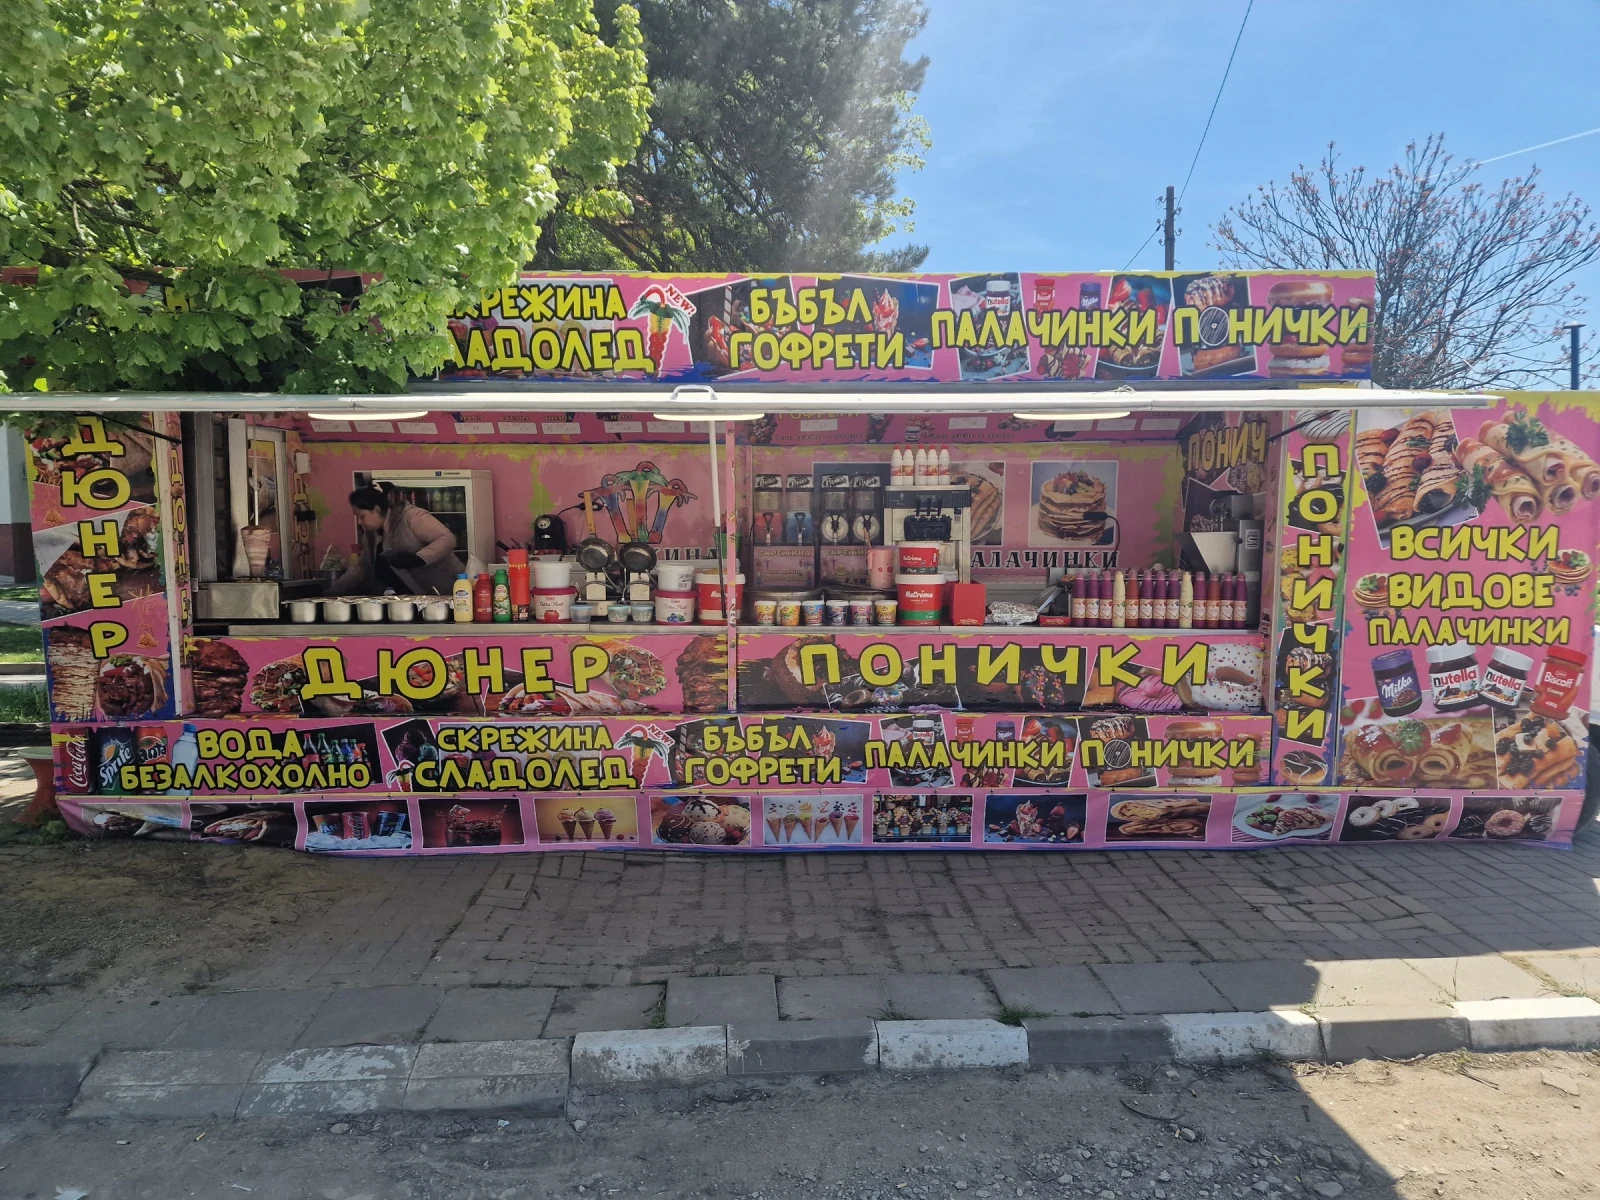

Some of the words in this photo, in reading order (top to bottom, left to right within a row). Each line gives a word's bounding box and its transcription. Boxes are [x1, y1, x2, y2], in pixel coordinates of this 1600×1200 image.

[665, 285, 696, 316] NEW!
[749, 285, 873, 326] БЪБЪЛ
[931, 307, 1157, 348] ПАЛАЧИНКИ
[1174, 305, 1370, 348] ПОНИЧКИ
[727, 331, 904, 372] ГОФРЕТИ
[60, 415, 131, 660] ДЮНЕР
[1391, 525, 1559, 562] ВСИЧКИ
[970, 551, 1119, 568] АЛАЧИНКИ
[1286, 443, 1341, 740] ПОНИЧКИ
[1387, 572, 1556, 610] ВИДОВЕ
[1368, 616, 1571, 647] ПАЛАЧИНКИ
[300, 643, 611, 701] ДЮНЕР
[800, 641, 1209, 689] ПОНИЧКИ
[1433, 668, 1477, 687] nutella
[1544, 671, 1575, 689] Biscoff
[1381, 676, 1413, 699] Milka
[1486, 671, 1522, 691] nutella
[197, 729, 304, 760] ВОДА
[436, 723, 614, 752] СКРЕЖИНА
[648, 725, 674, 746] NEW!
[702, 724, 813, 753] БЪБЪЛ
[100, 746, 132, 787] Sprite
[864, 739, 1064, 770] ПАЛАЧИНКИ
[1080, 738, 1256, 770] ПОНИЧКИ
[120, 763, 371, 790] БЕЗАЛКОХОЛНО
[414, 756, 638, 791] СЛАДОЛЕД
[684, 757, 842, 786] ГОФРЕТИ
